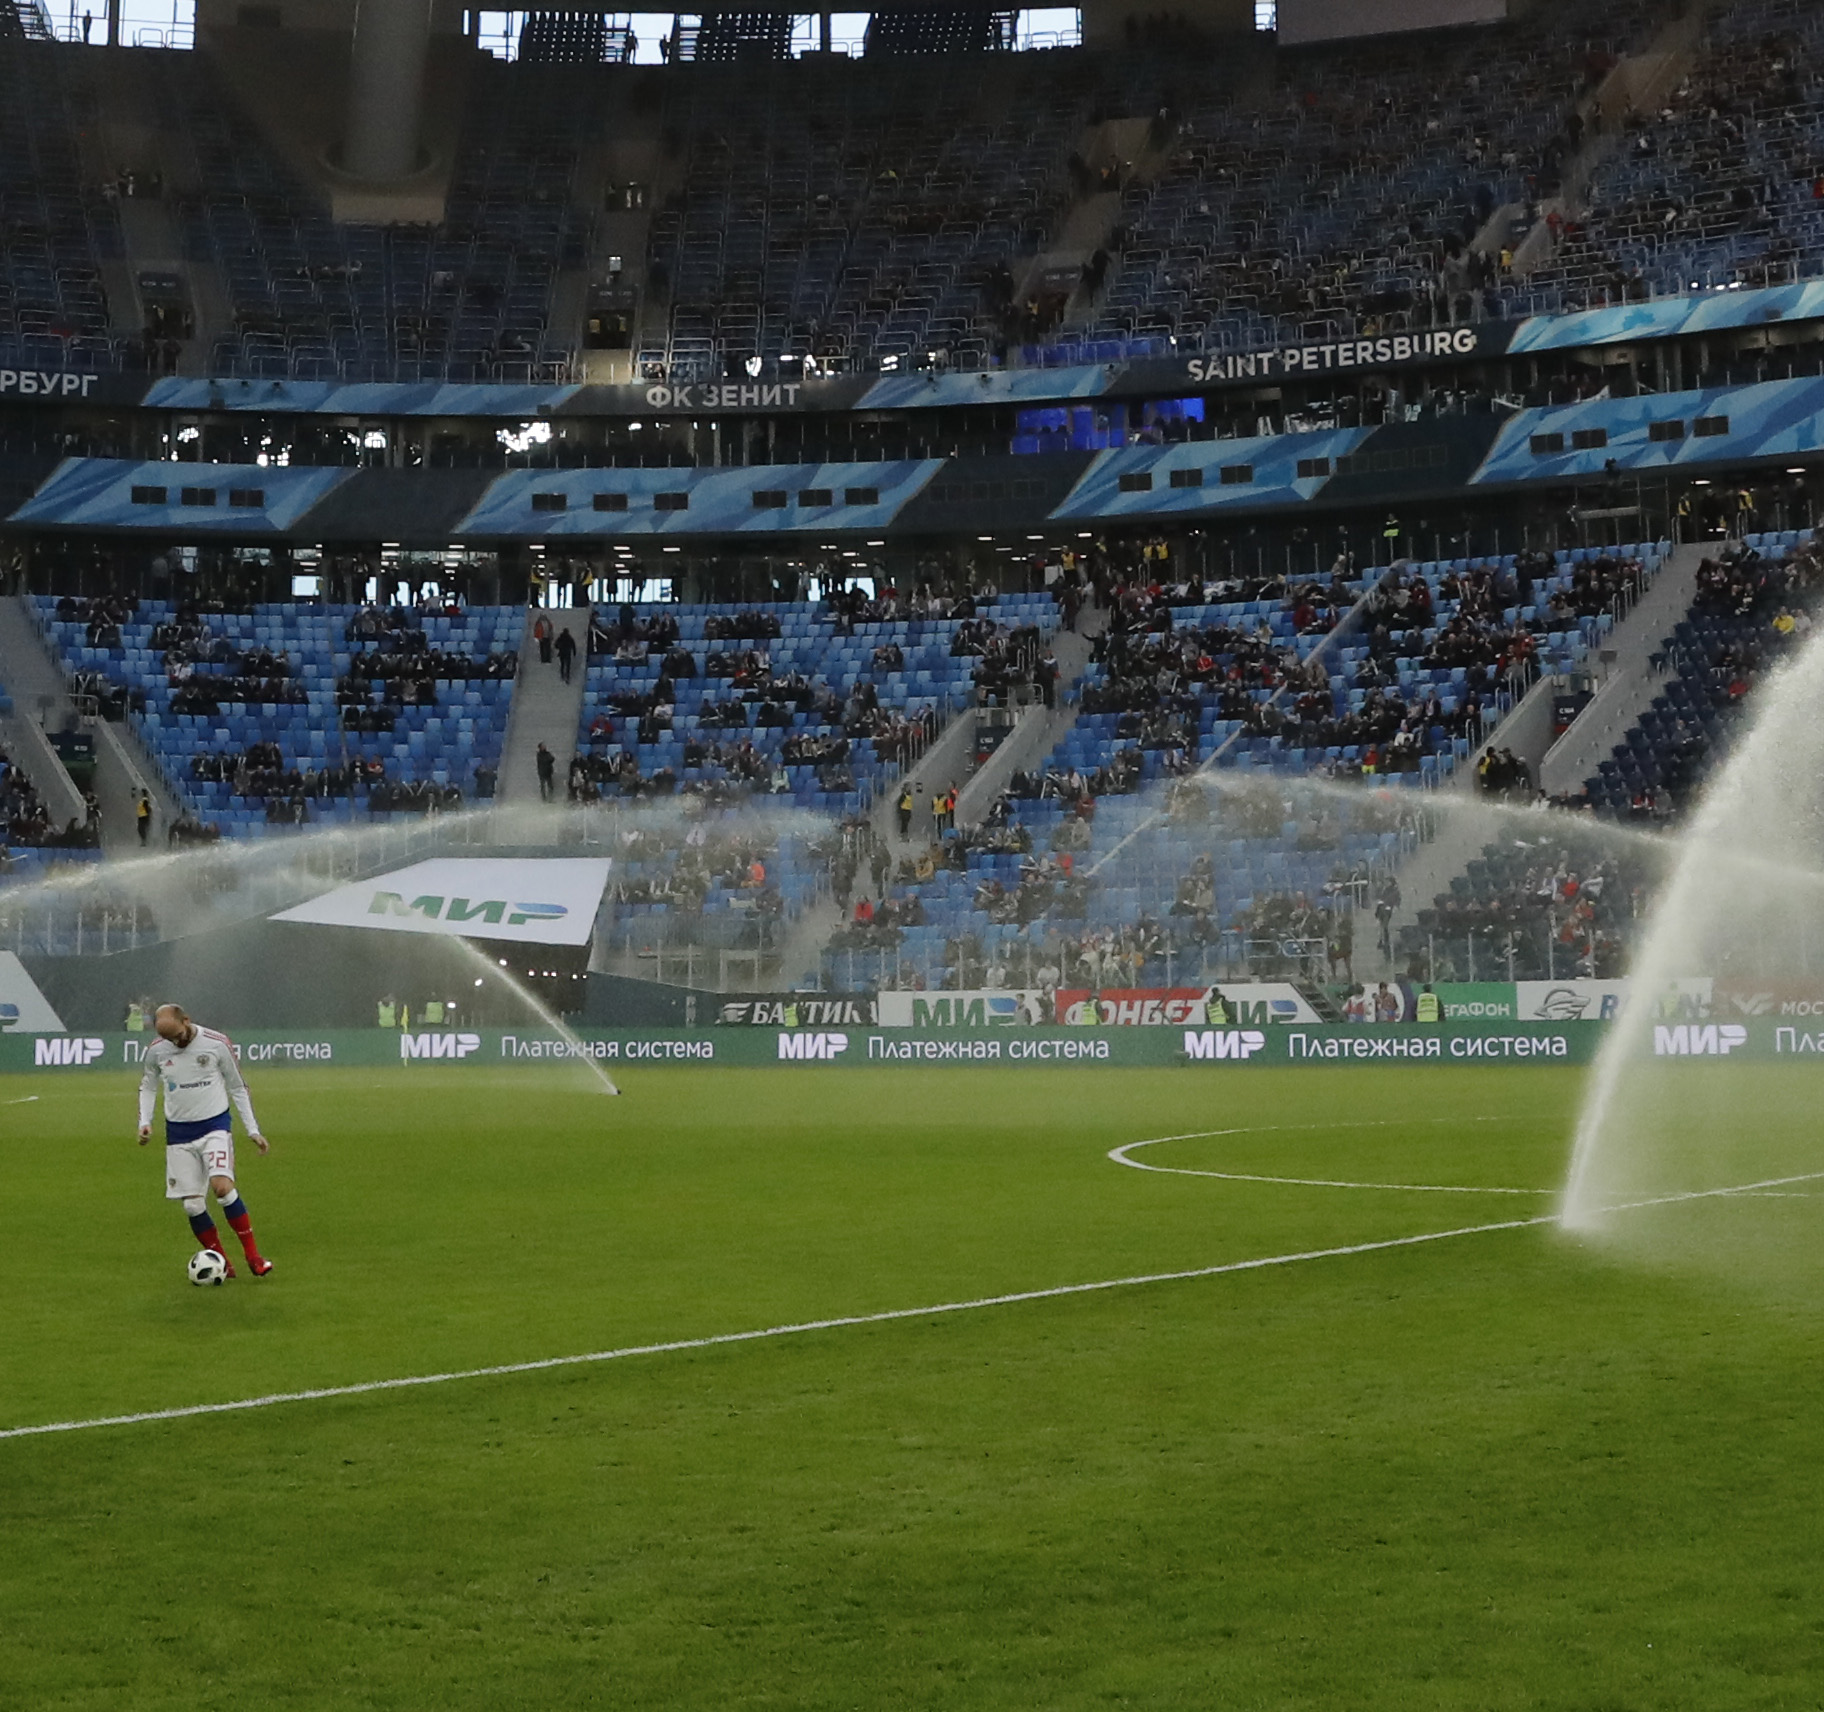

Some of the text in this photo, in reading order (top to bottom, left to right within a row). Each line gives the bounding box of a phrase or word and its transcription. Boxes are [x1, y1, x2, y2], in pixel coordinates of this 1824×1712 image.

[1187, 328, 1475, 382] SAINT PETERSBURG
[646, 384, 800, 409] ФК ЗЕНИТ
[367, 891, 568, 926] МИР
[913, 997, 1017, 1027] МИР
[34, 1038, 104, 1066] МИР
[247, 1042, 332, 1061] система
[400, 1033, 714, 1060] МИР Платежная система
[778, 1032, 1109, 1060] МИР Платежная система
[1184, 1030, 1567, 1059] МИР Платежная система
[1654, 1024, 1748, 1056] МИР
[209, 1150, 227, 1169] 22
